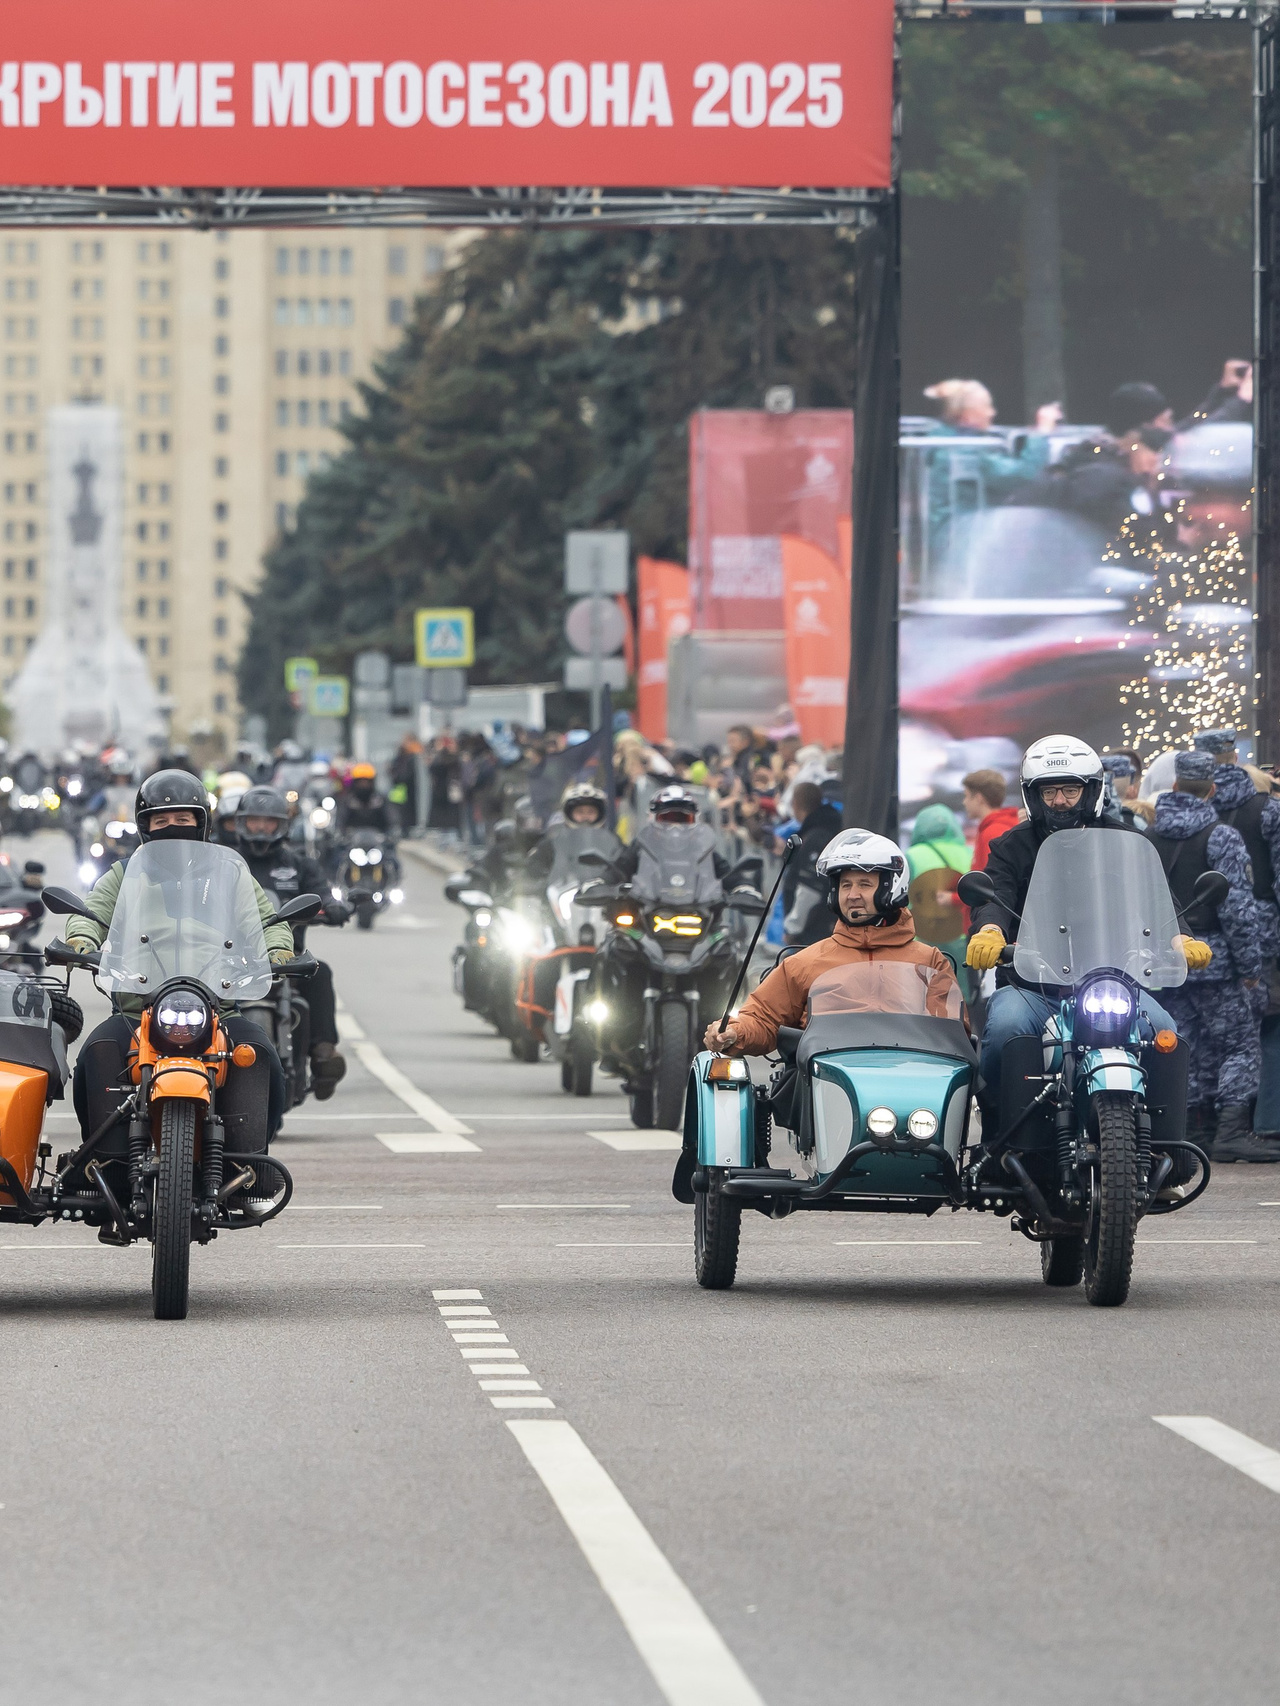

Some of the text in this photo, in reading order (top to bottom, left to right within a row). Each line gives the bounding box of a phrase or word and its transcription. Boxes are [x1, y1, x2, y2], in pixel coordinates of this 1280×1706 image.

[252, 61, 674, 128] МОТОСЕЗОНА
[691, 62, 844, 129] 2025
[1046, 759, 1068, 767] SHOEI
